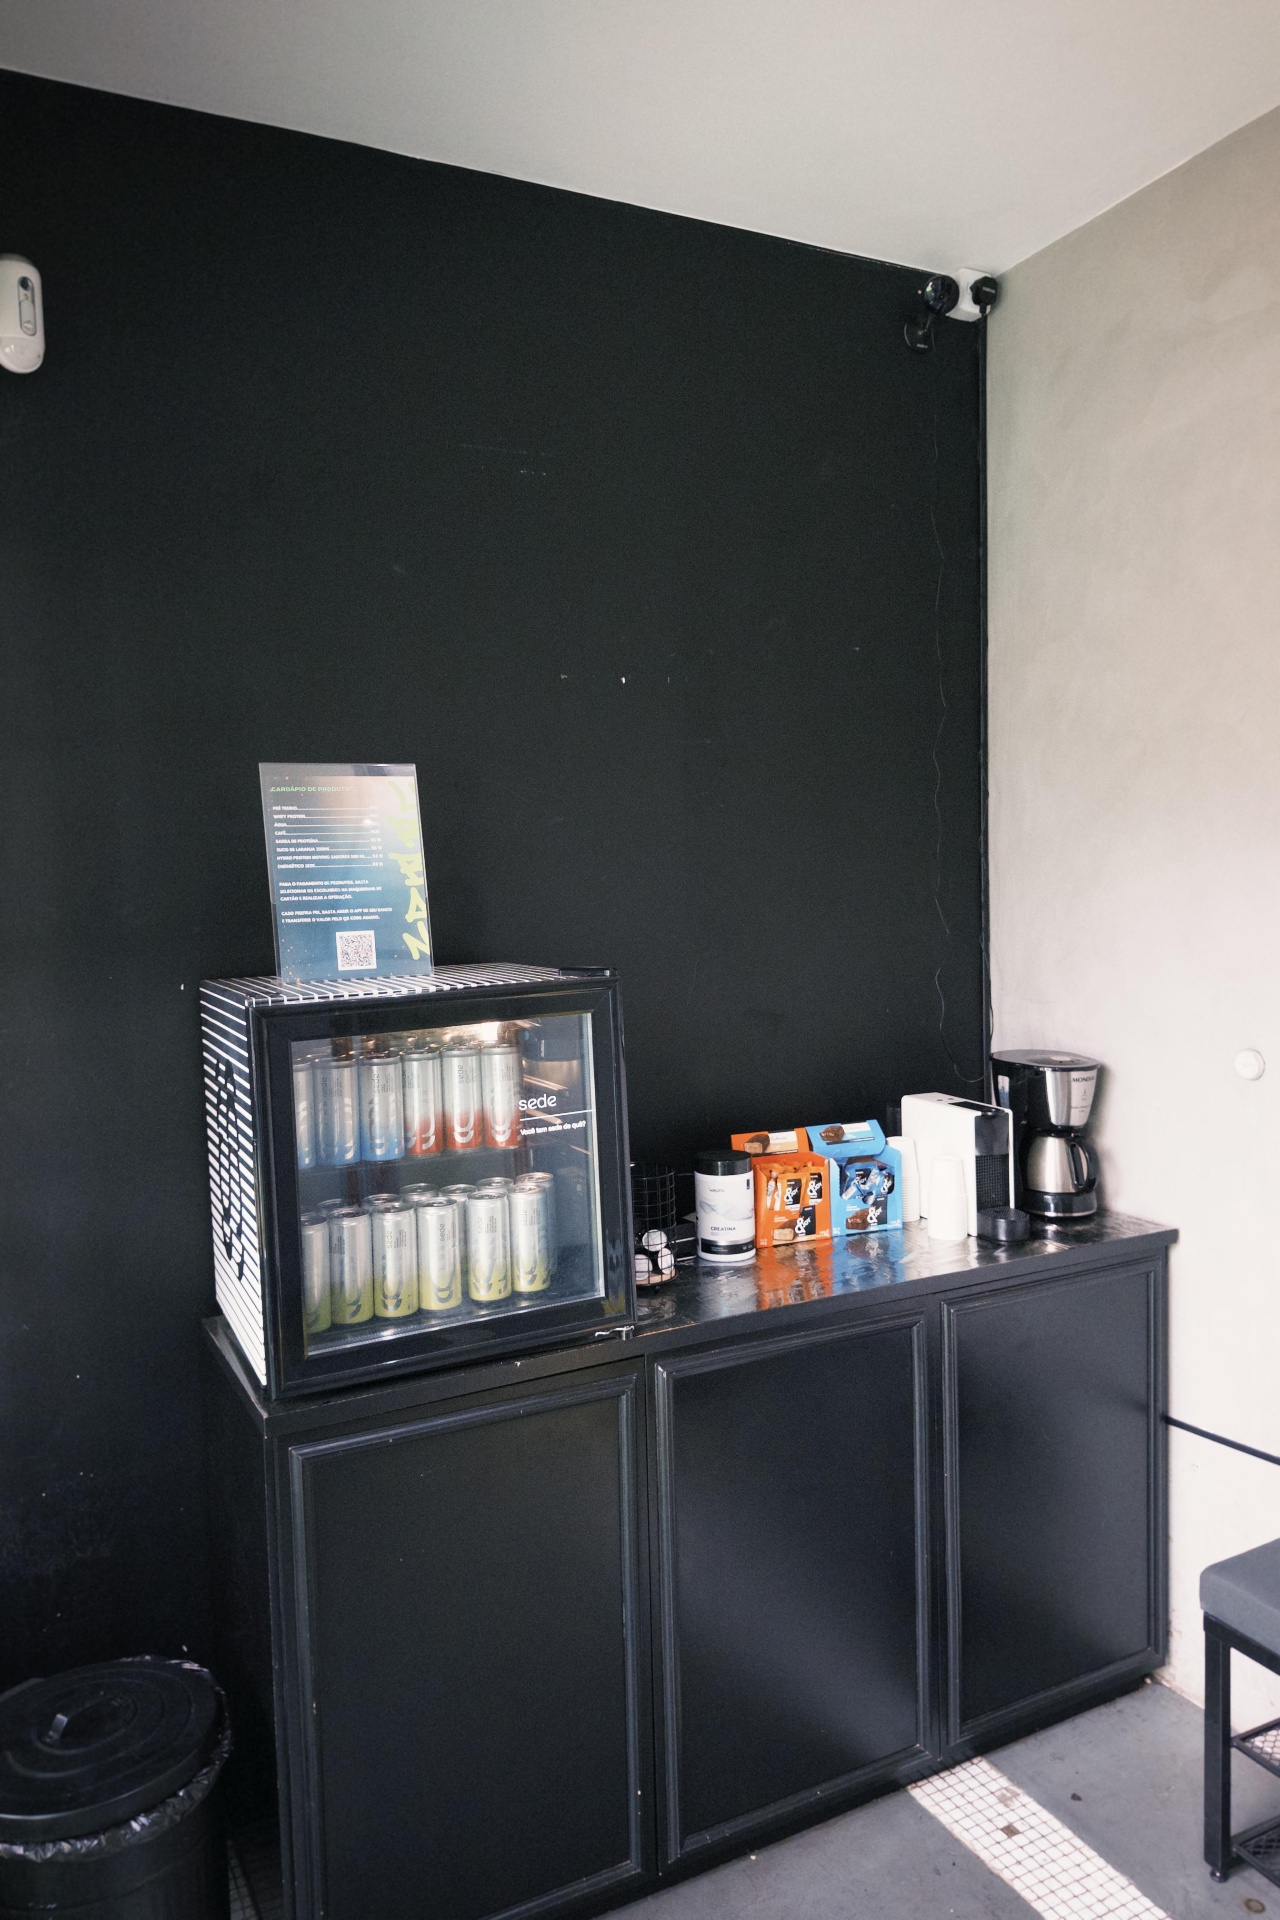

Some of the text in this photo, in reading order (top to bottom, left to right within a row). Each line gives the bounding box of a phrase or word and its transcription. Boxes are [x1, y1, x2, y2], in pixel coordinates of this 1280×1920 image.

[518, 1093, 557, 1111] sede
[520, 1120, 587, 1136] Você tem sede de quê?
